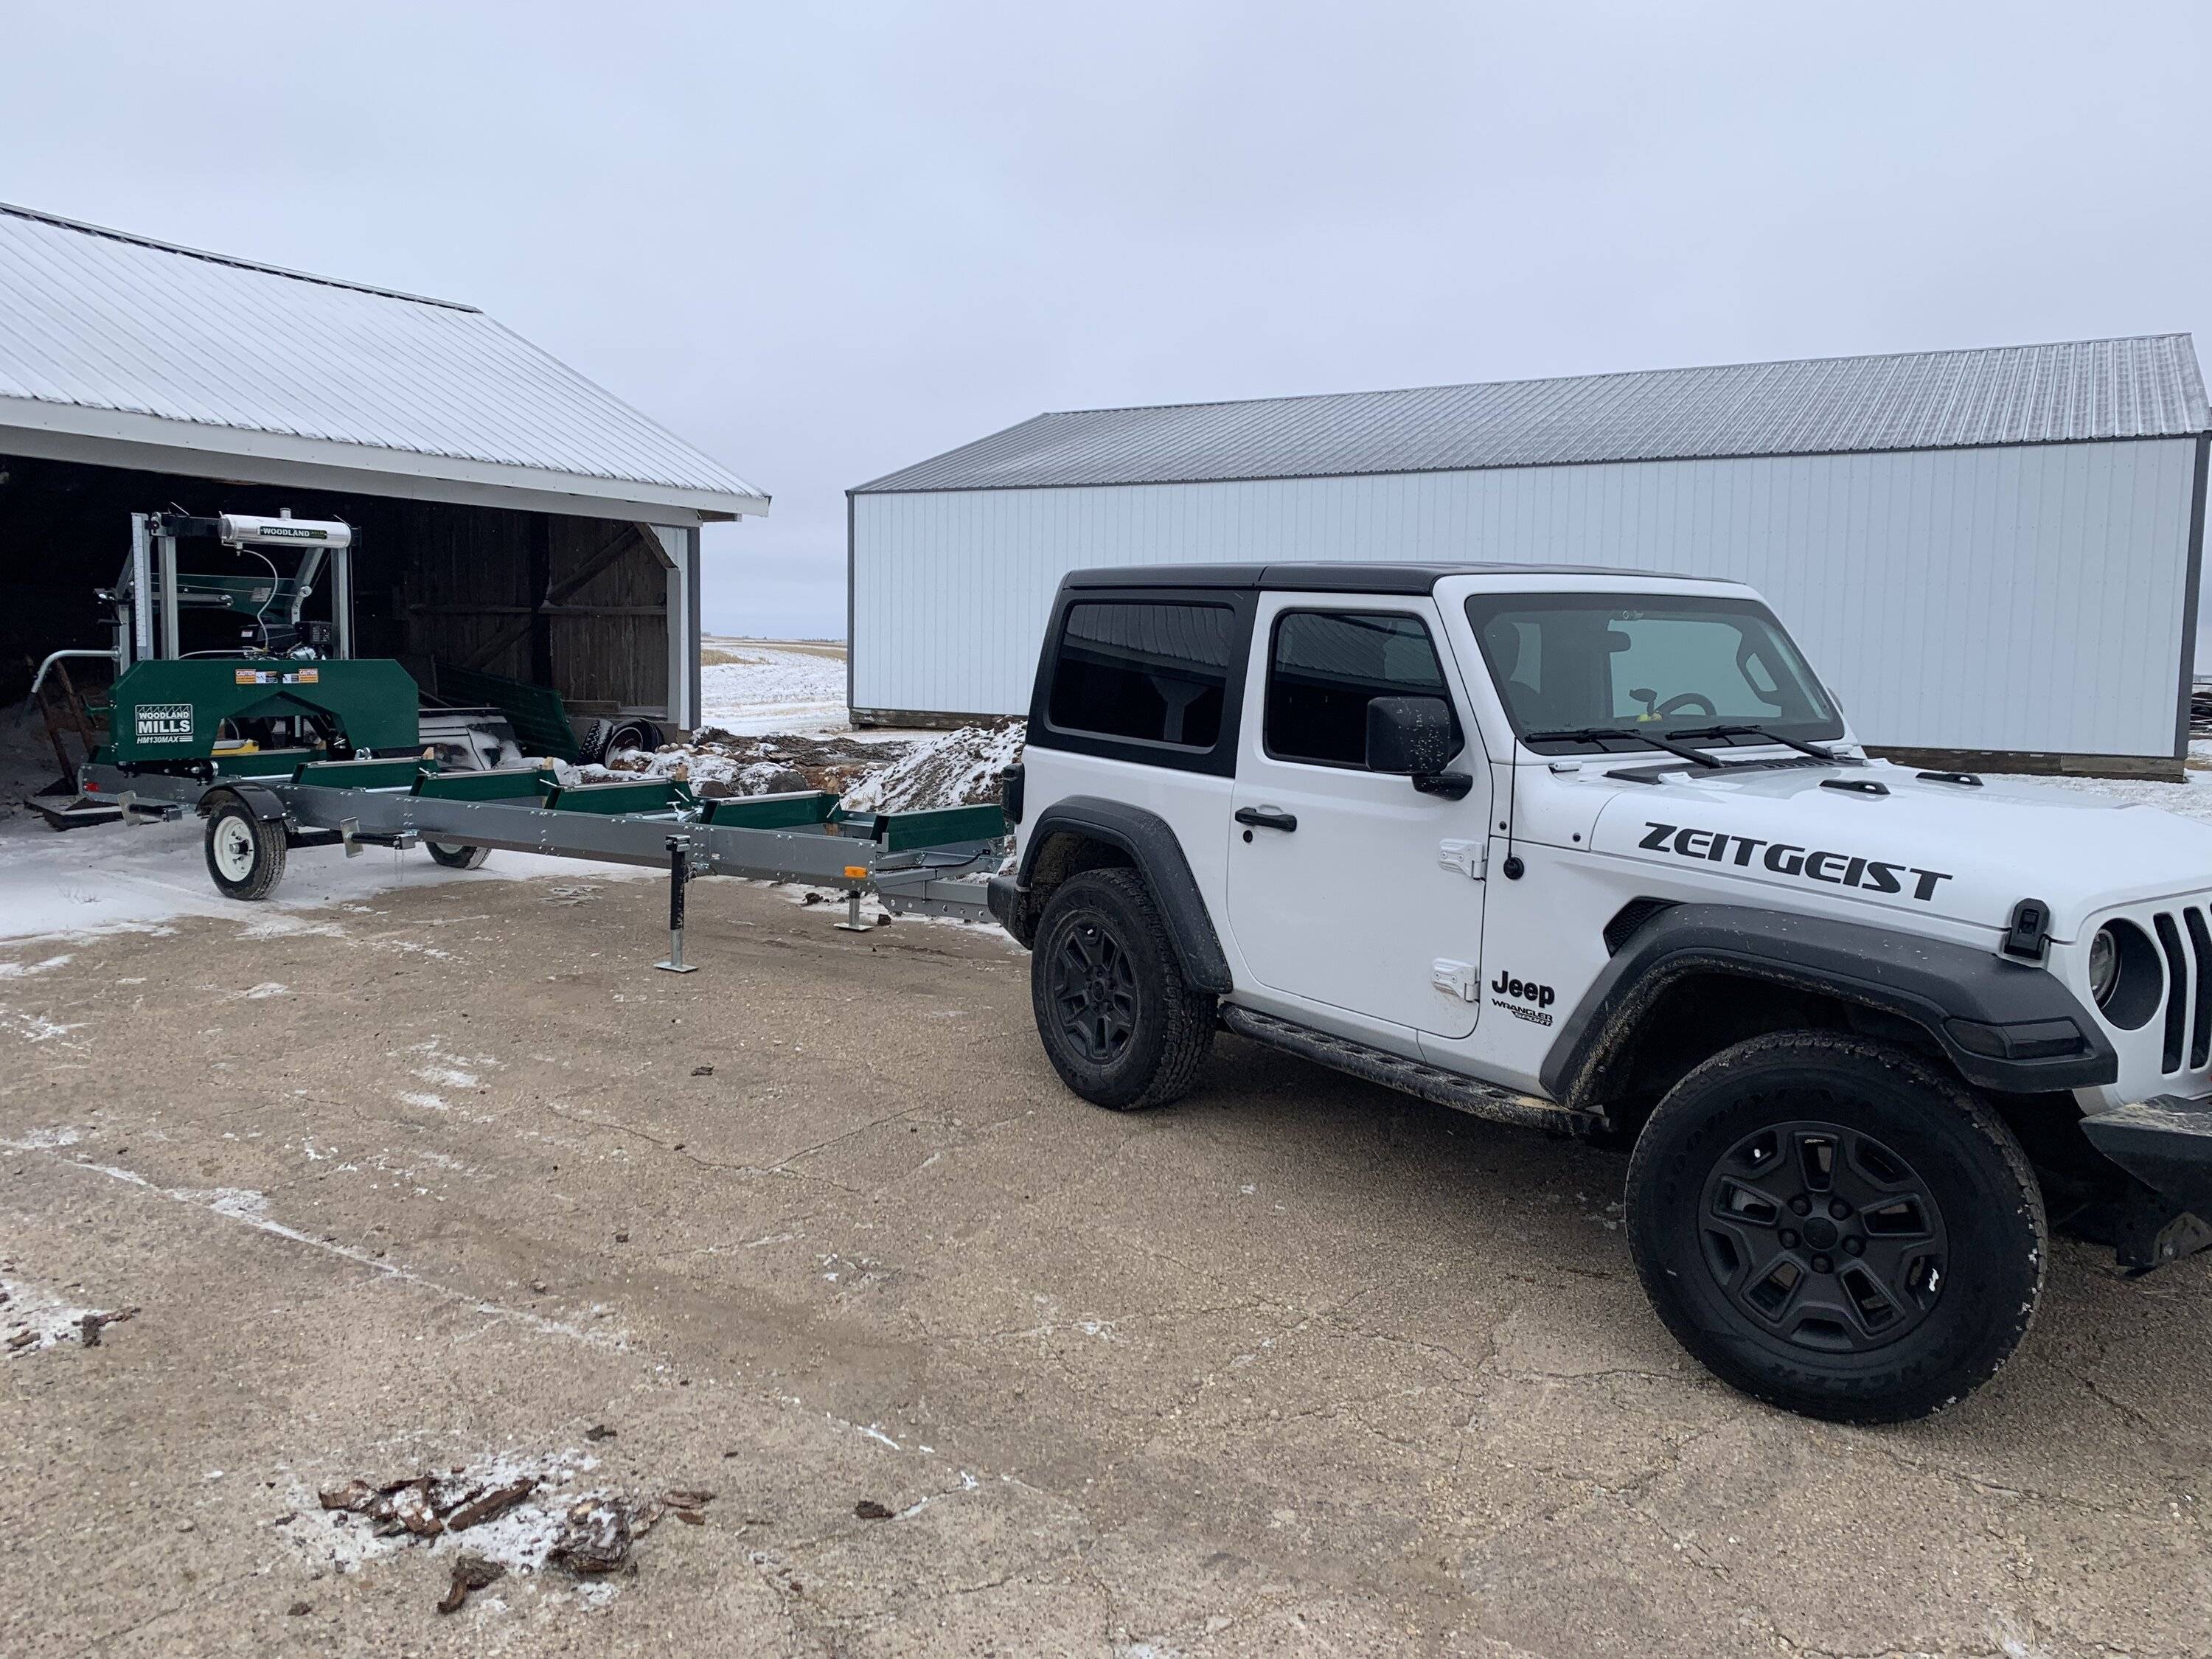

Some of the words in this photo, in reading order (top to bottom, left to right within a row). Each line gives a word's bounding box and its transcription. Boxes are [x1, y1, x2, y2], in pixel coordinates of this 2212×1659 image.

[262, 527, 310, 538] WOODLAND
[139, 712, 190, 720] WOODLAND
[138, 720, 191, 734] MILLS
[136, 736, 178, 744] HM130MAX
[1638, 821, 1953, 902] ZEITGEIST
[1492, 970, 1555, 1008] Jeep
[1492, 998, 1553, 1021] WRANGLER
